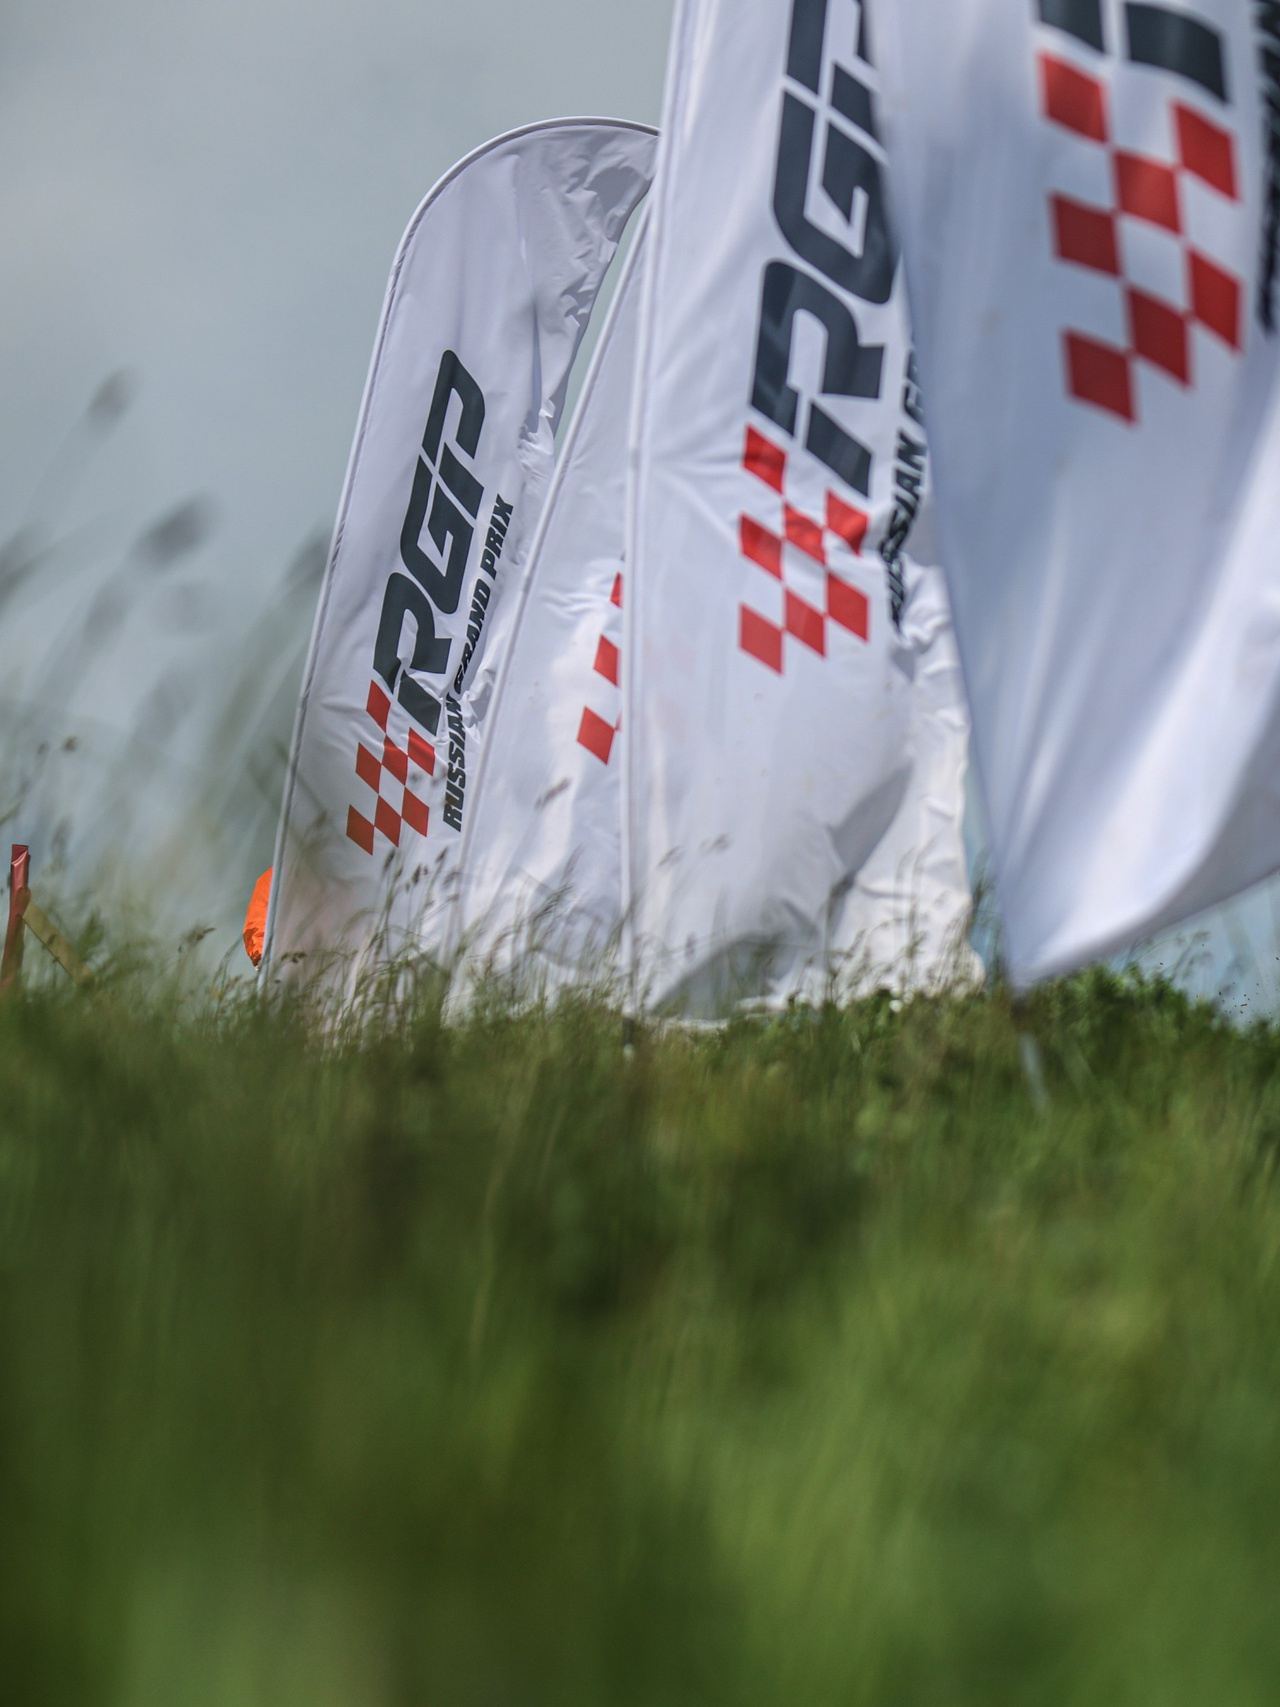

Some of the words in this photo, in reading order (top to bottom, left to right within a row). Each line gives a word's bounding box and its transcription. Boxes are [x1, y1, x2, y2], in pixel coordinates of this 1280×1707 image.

[373, 349, 486, 737] RGP
[480, 493, 514, 581] PRIX
[453, 578, 491, 695] GRAND
[442, 691, 467, 833] RUSSIAN
